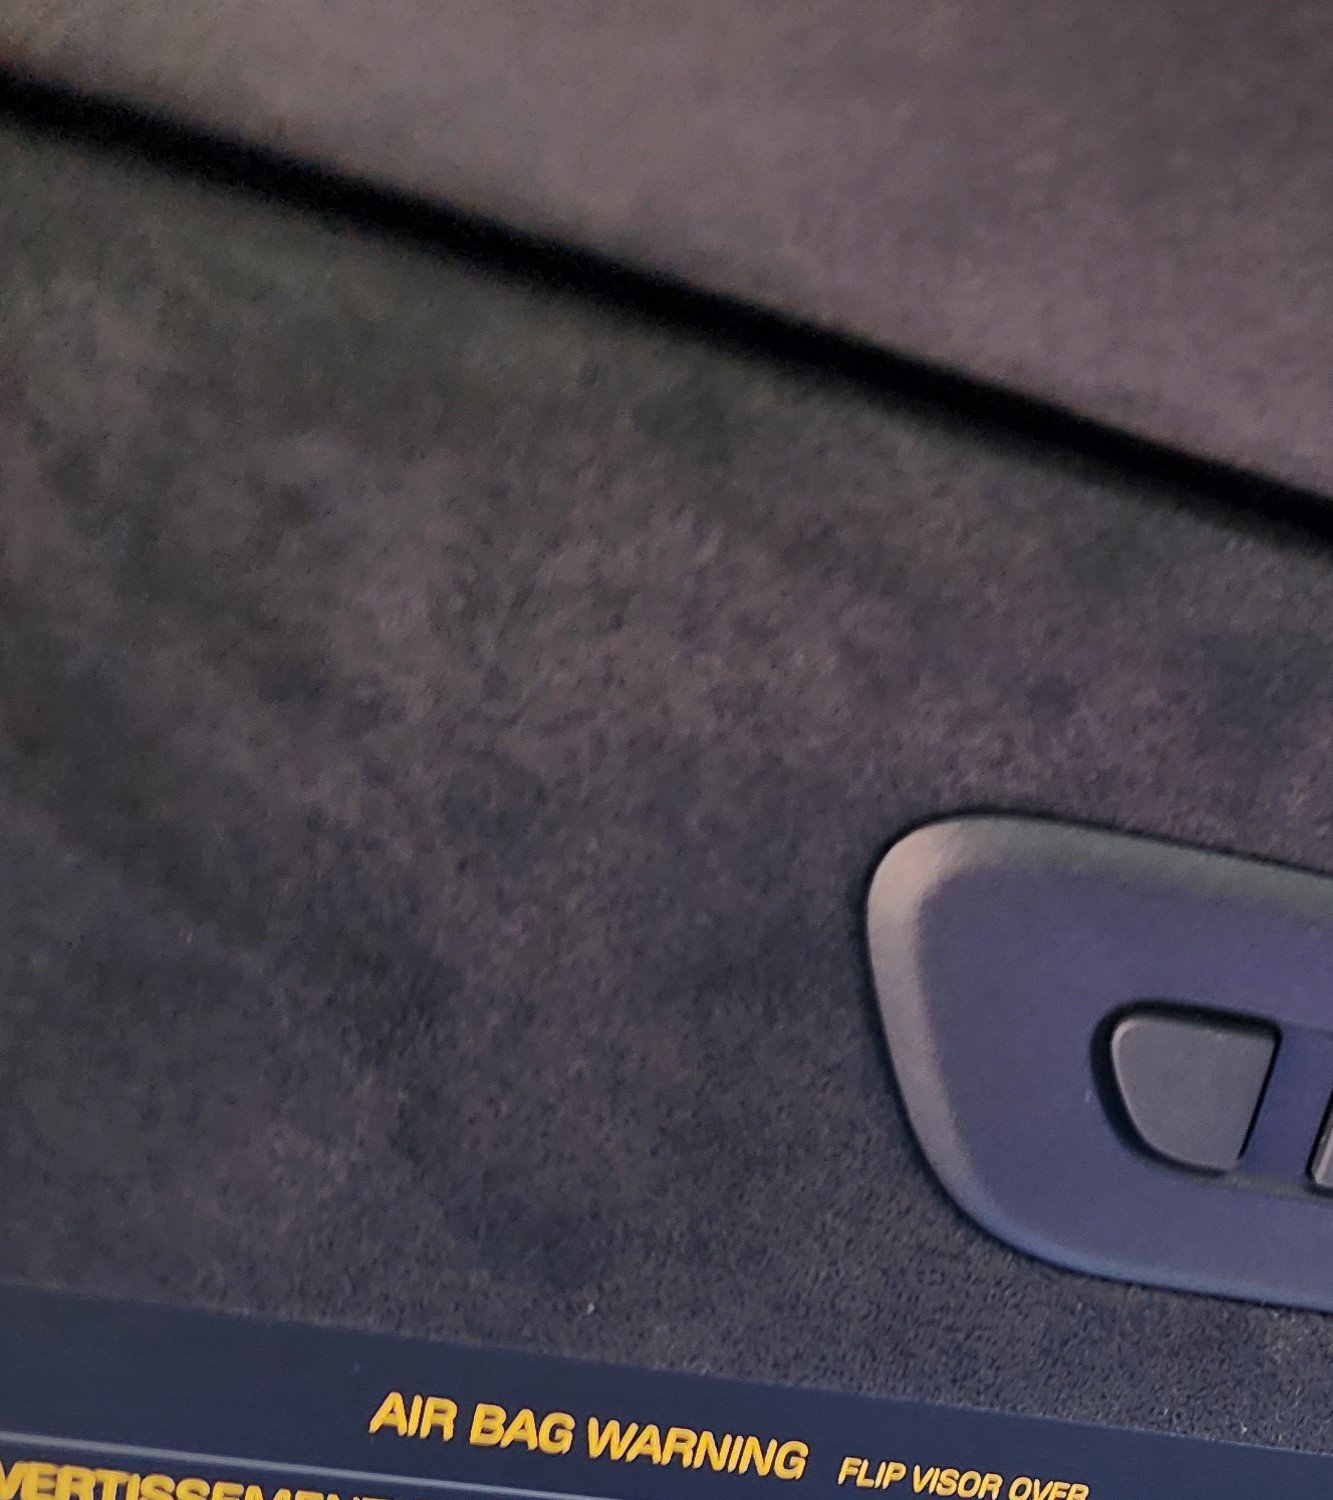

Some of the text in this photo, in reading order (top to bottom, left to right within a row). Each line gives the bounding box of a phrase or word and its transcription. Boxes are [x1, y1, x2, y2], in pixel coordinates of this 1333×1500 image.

[370, 1392, 458, 1443] AIR
[470, 1403, 575, 1455] BAG
[587, 1417, 809, 1480] WARNING
[837, 1456, 906, 1491] FLIP
[912, 1466, 1002, 1500] VISOR
